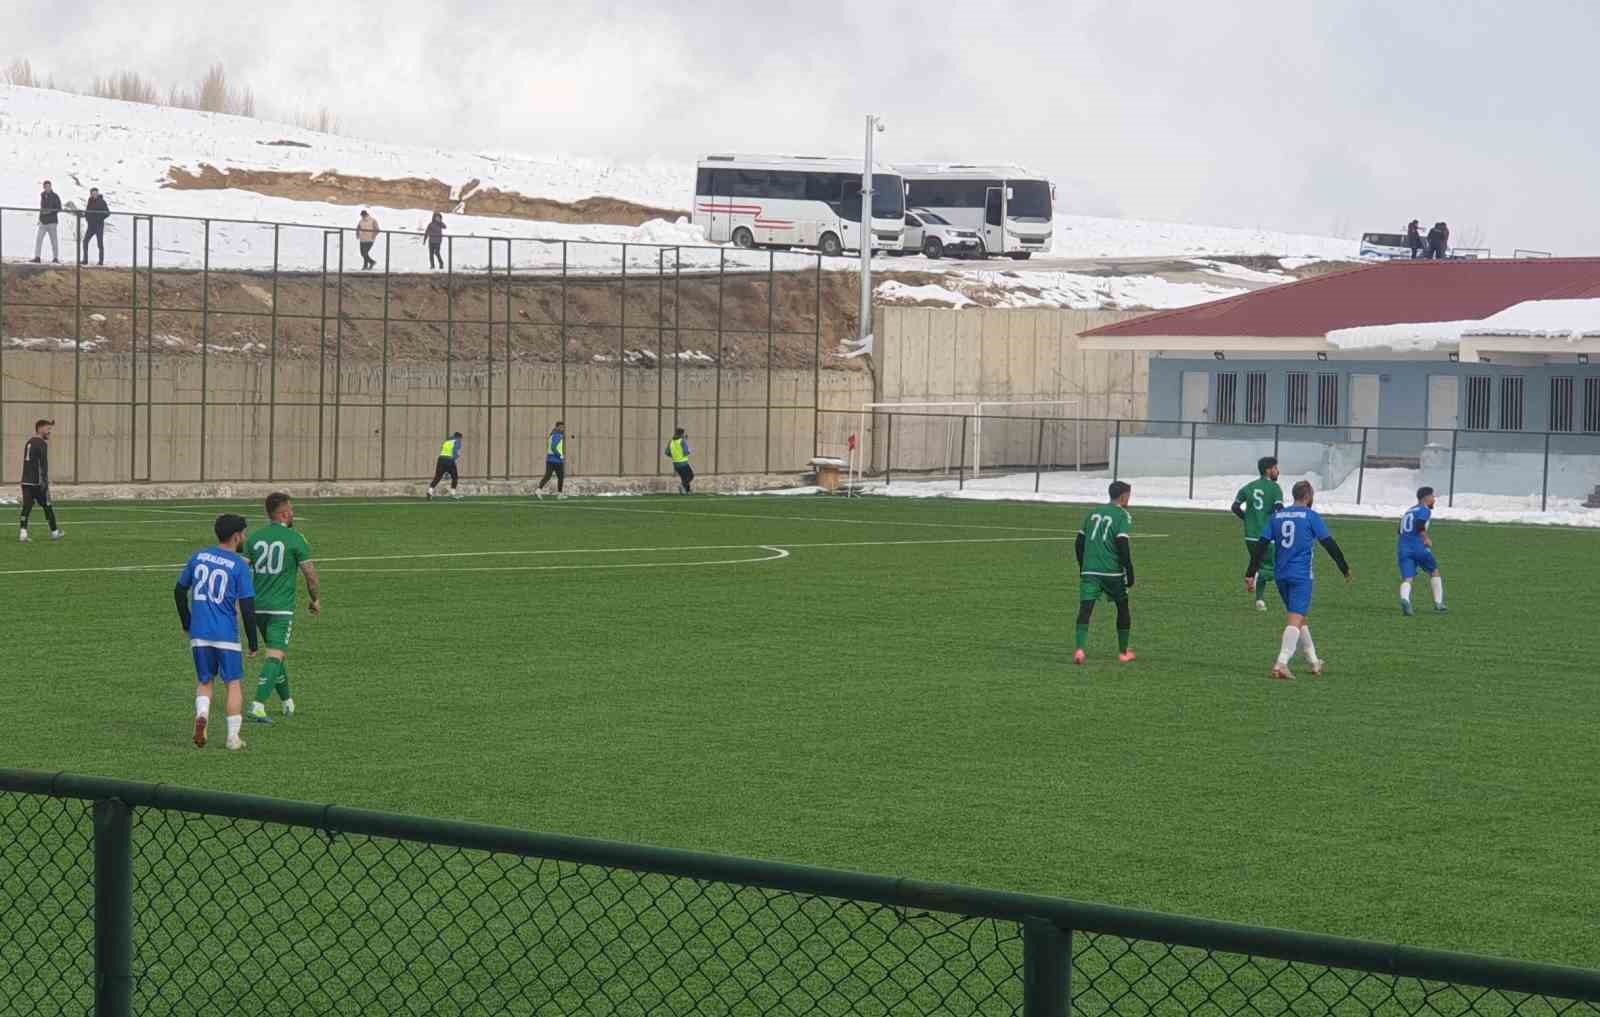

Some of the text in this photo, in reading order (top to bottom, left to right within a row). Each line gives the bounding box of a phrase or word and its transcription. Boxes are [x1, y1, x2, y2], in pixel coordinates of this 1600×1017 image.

[1090, 514, 1112, 540] 77
[1281, 520, 1295, 548] 9
[253, 541, 285, 574] 20
[194, 564, 228, 604] 20
